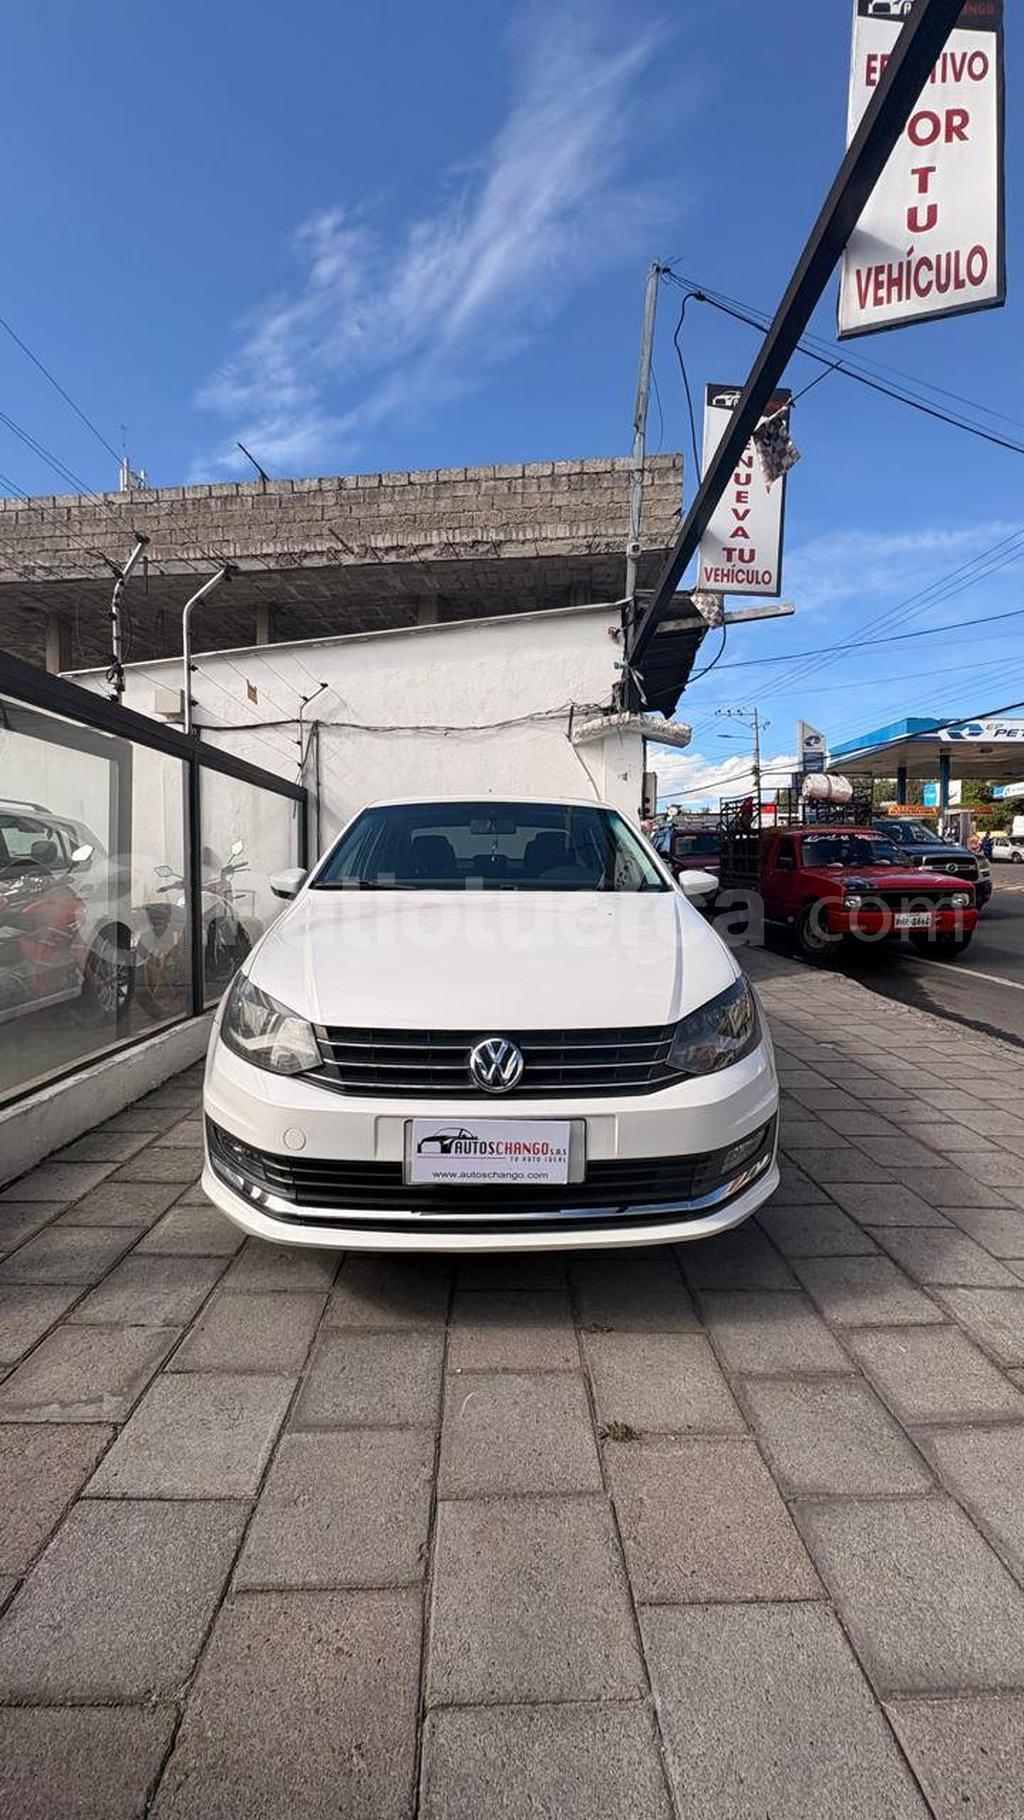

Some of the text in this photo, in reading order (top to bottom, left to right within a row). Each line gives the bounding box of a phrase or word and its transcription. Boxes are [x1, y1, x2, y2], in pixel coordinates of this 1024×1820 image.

[855, 244, 989, 311] VEHÍCULO
[722, 547, 756, 564] TU
[704, 564, 772, 585] VEHÍCULO
[455, 1141, 549, 1156] AUTOSCHANGO
